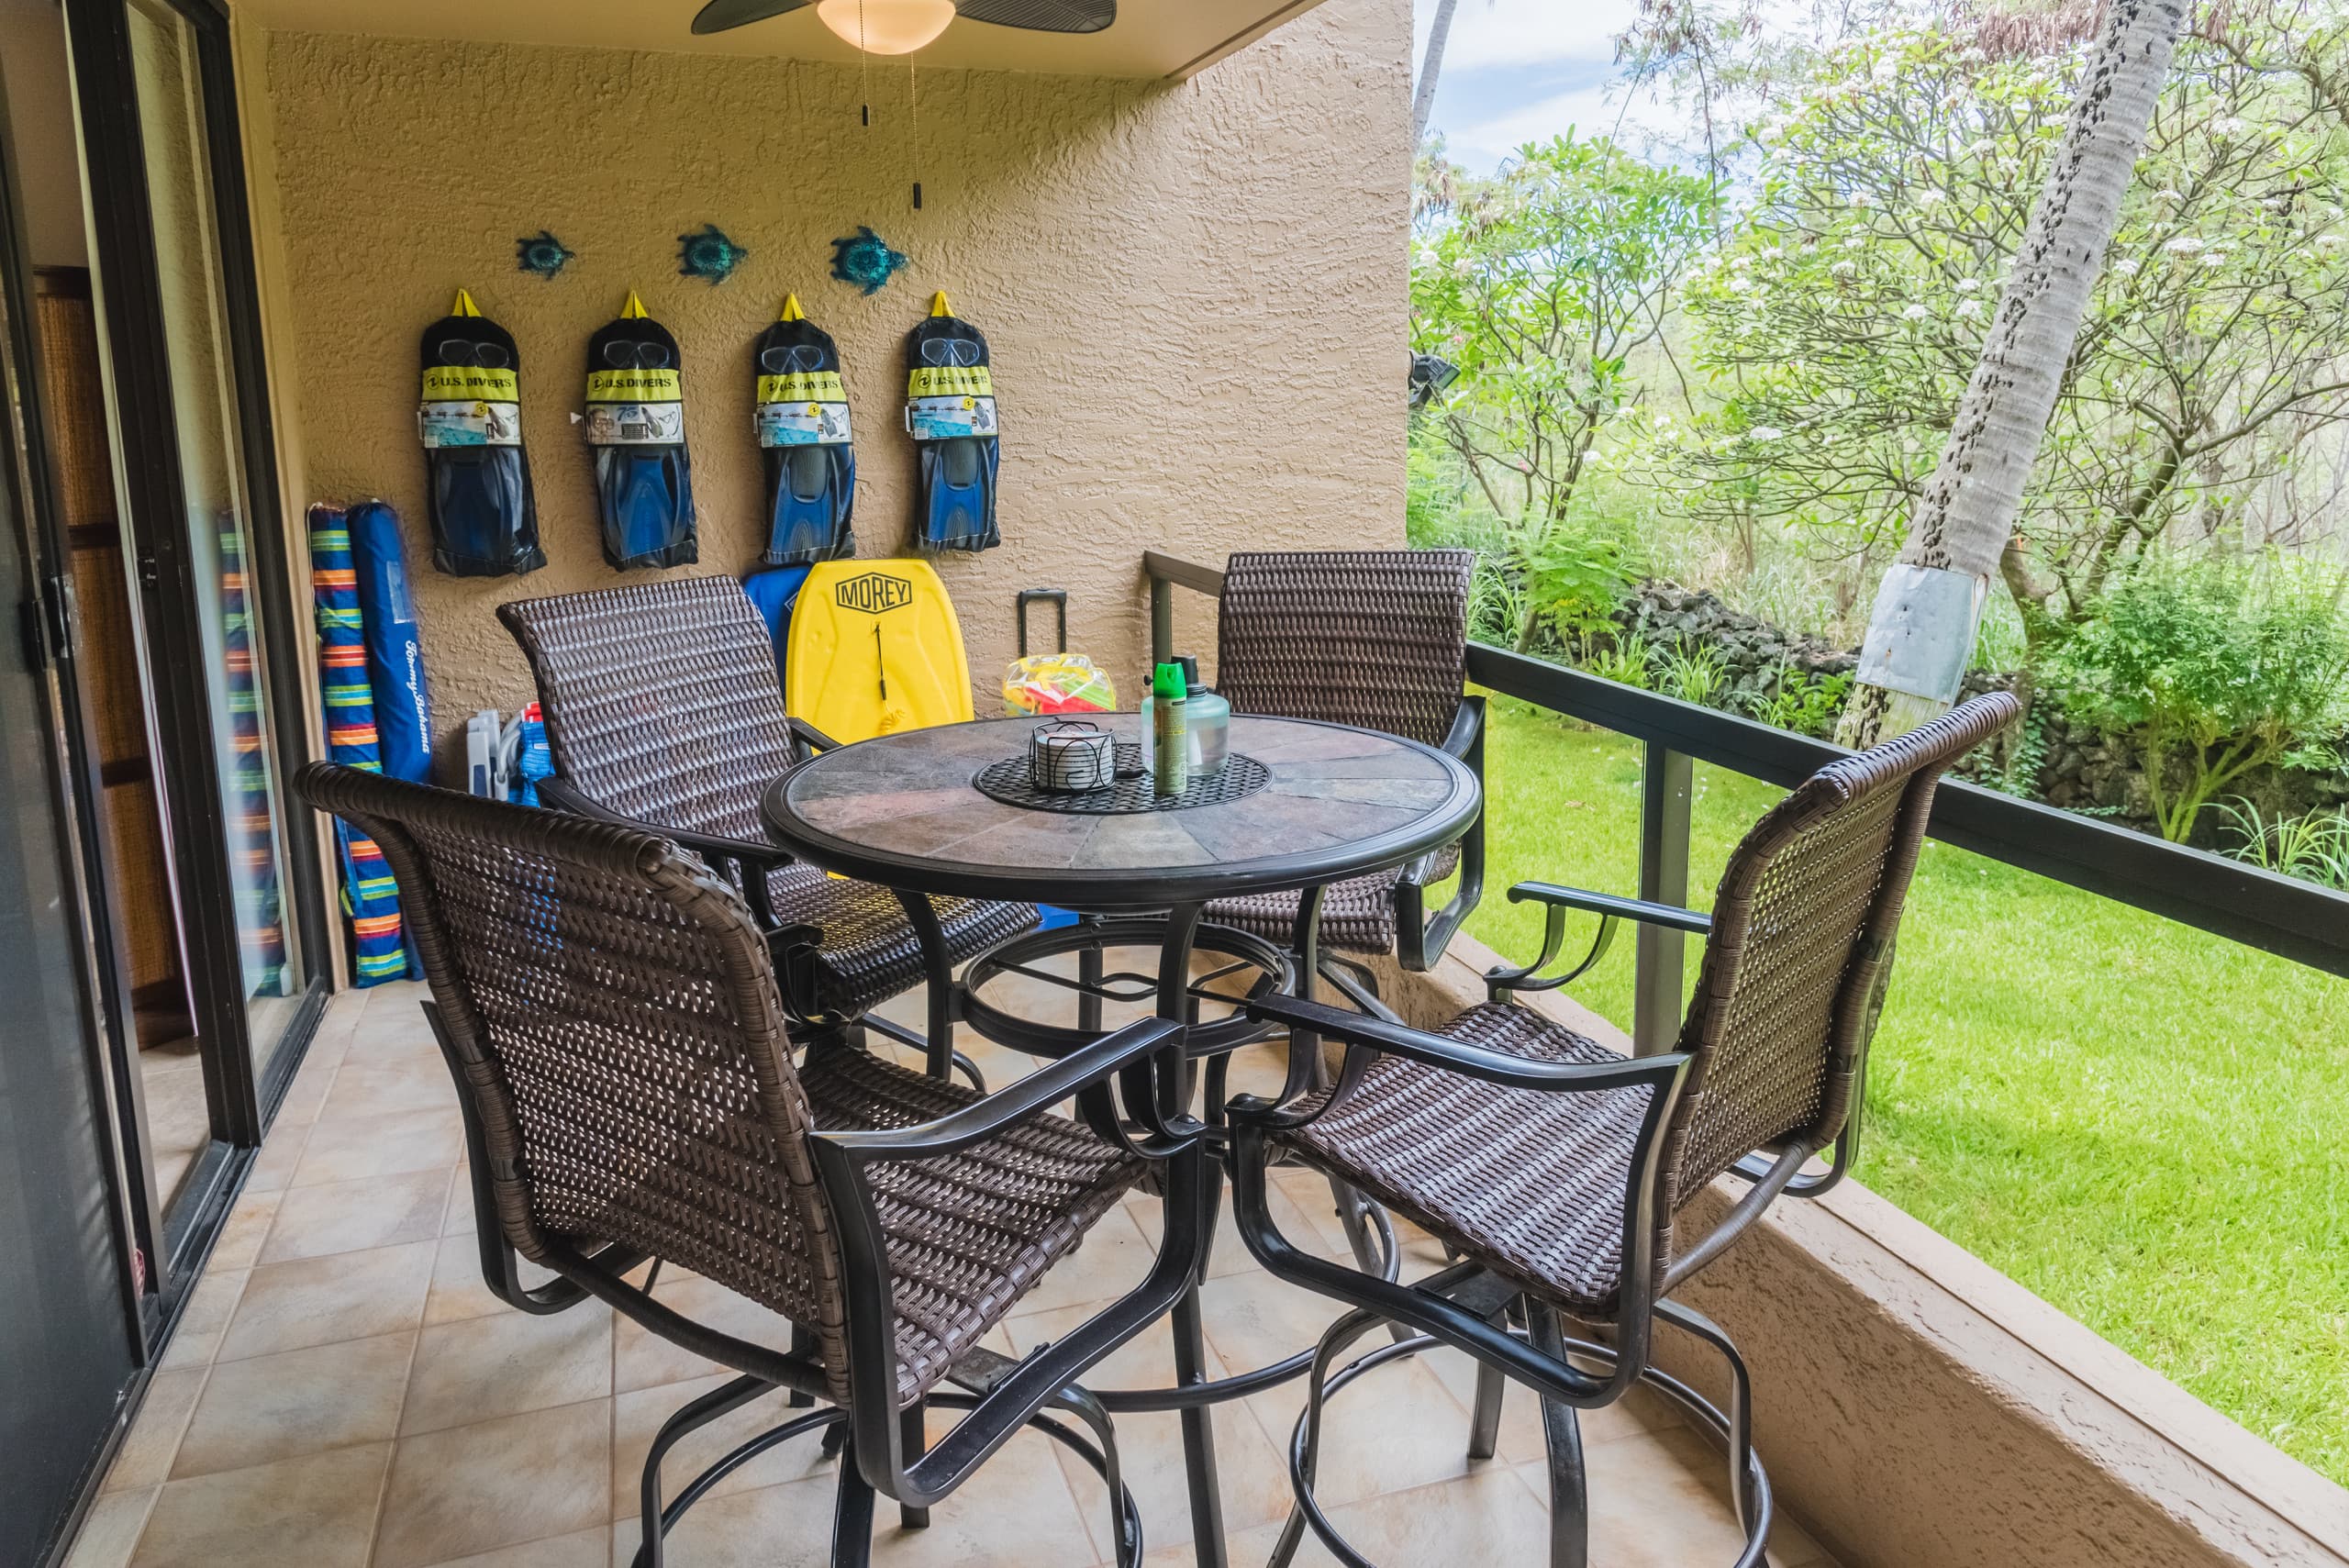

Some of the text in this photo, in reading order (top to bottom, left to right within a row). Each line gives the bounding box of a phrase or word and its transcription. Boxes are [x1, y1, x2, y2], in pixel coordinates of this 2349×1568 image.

[440, 376, 512, 389] U.S. DIVERS
[626, 378, 673, 389] DIVERS
[841, 575, 907, 611] MOREY
[405, 639, 430, 754] Tommy Bahama
